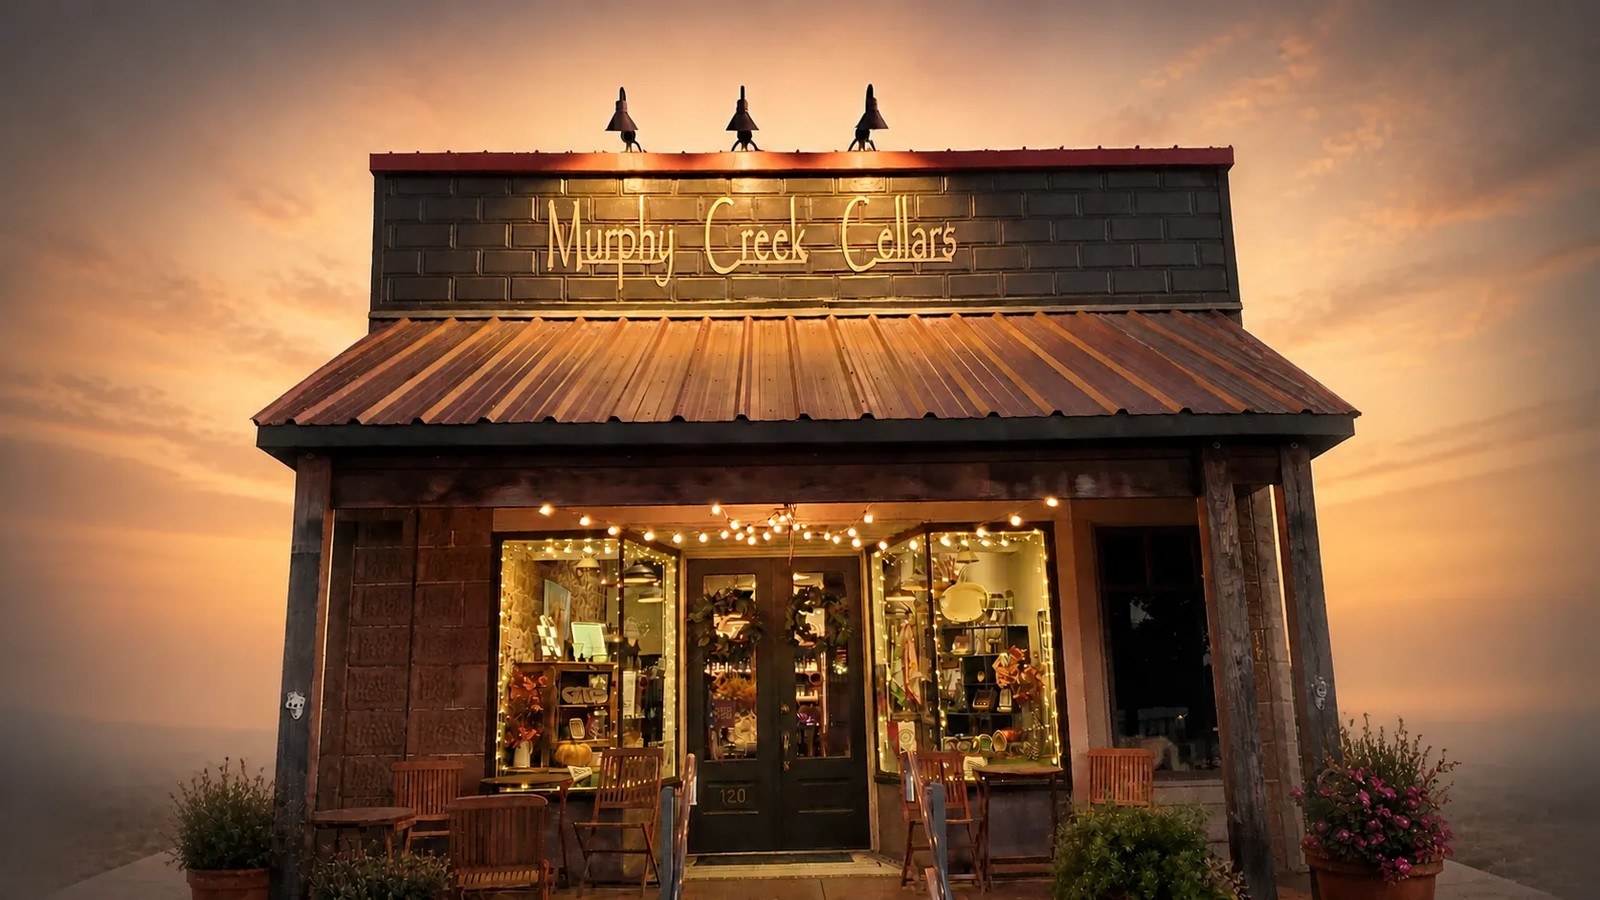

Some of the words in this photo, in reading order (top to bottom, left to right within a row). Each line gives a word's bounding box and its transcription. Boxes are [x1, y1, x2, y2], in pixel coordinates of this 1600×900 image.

[548, 195, 675, 290] Murphy
[705, 196, 809, 275] Creek
[842, 195, 958, 273] Cellars
[719, 788, 746, 803] 120
